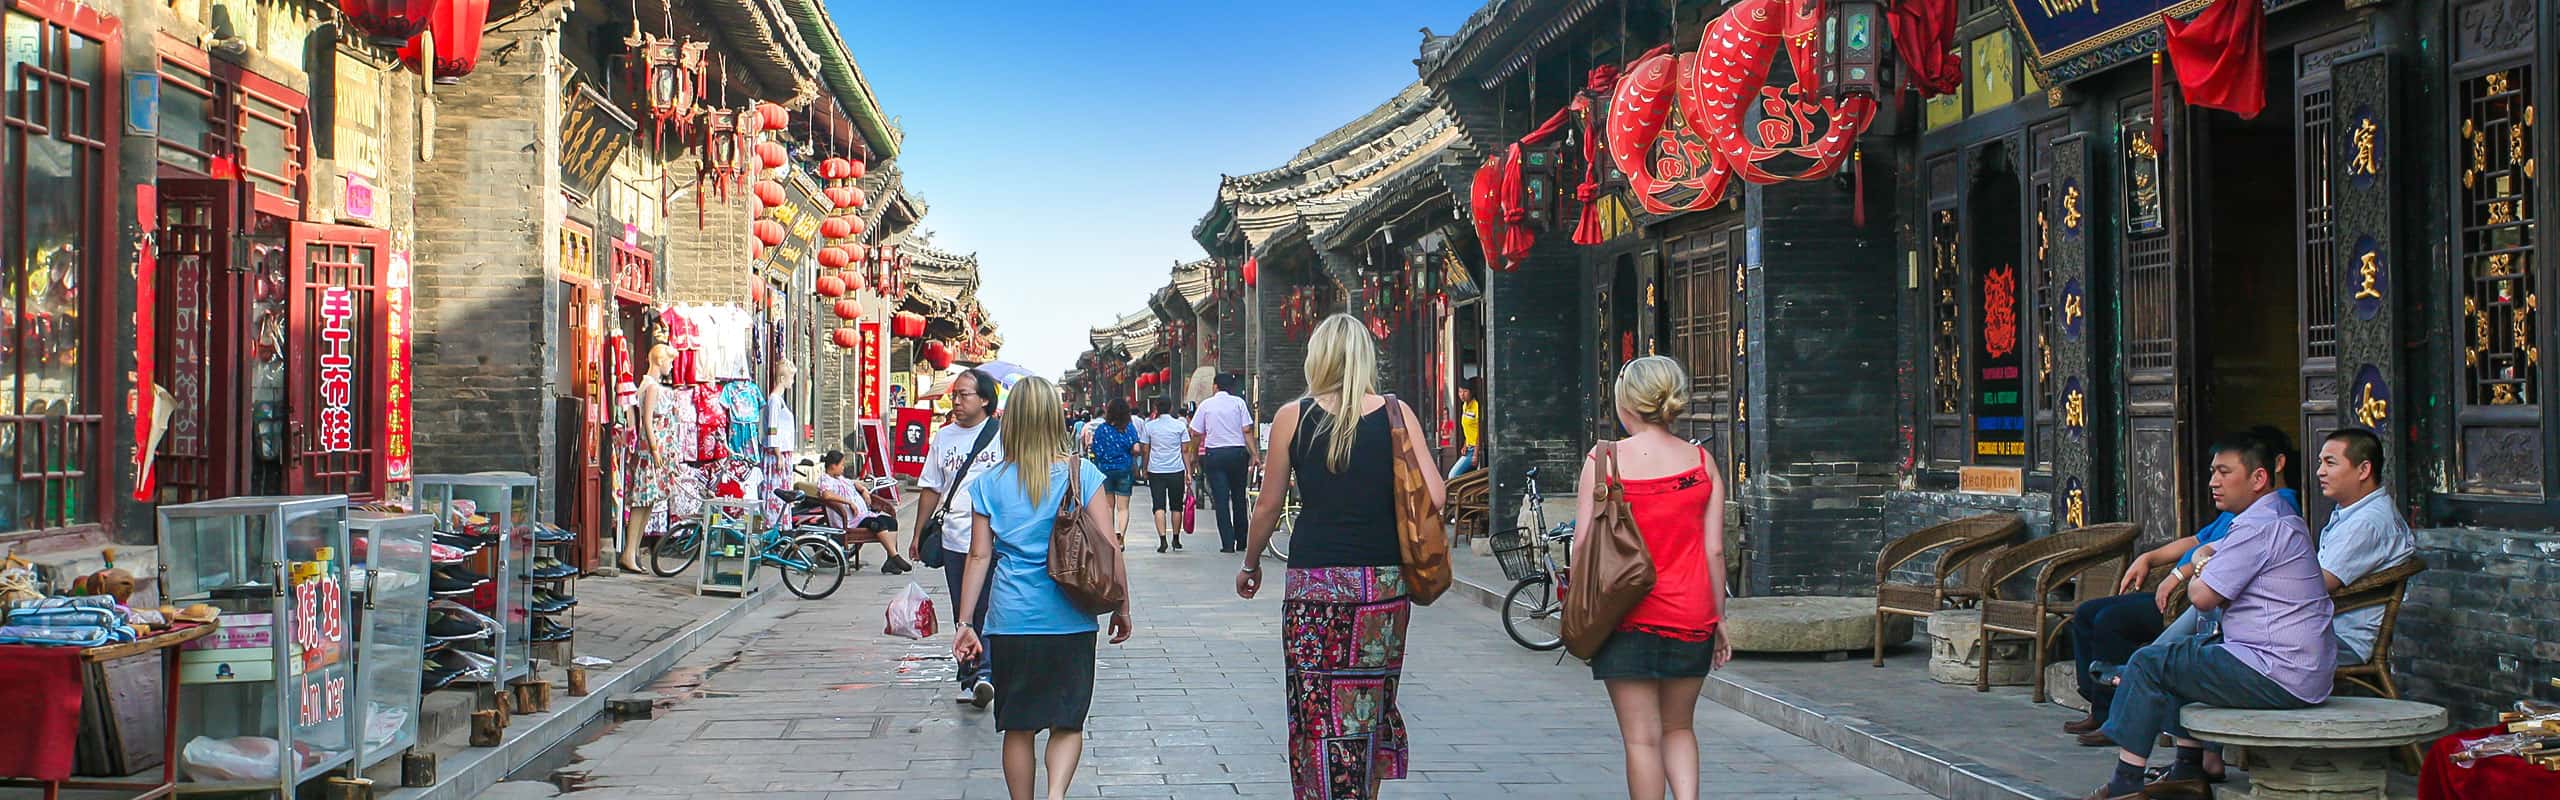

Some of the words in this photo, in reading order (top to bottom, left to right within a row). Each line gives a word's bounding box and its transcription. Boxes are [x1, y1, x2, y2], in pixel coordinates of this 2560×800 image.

[321, 287, 351, 451] 手工布鞋
[1961, 470, 2015, 492] Reception
[297, 574, 342, 651] 琥珀
